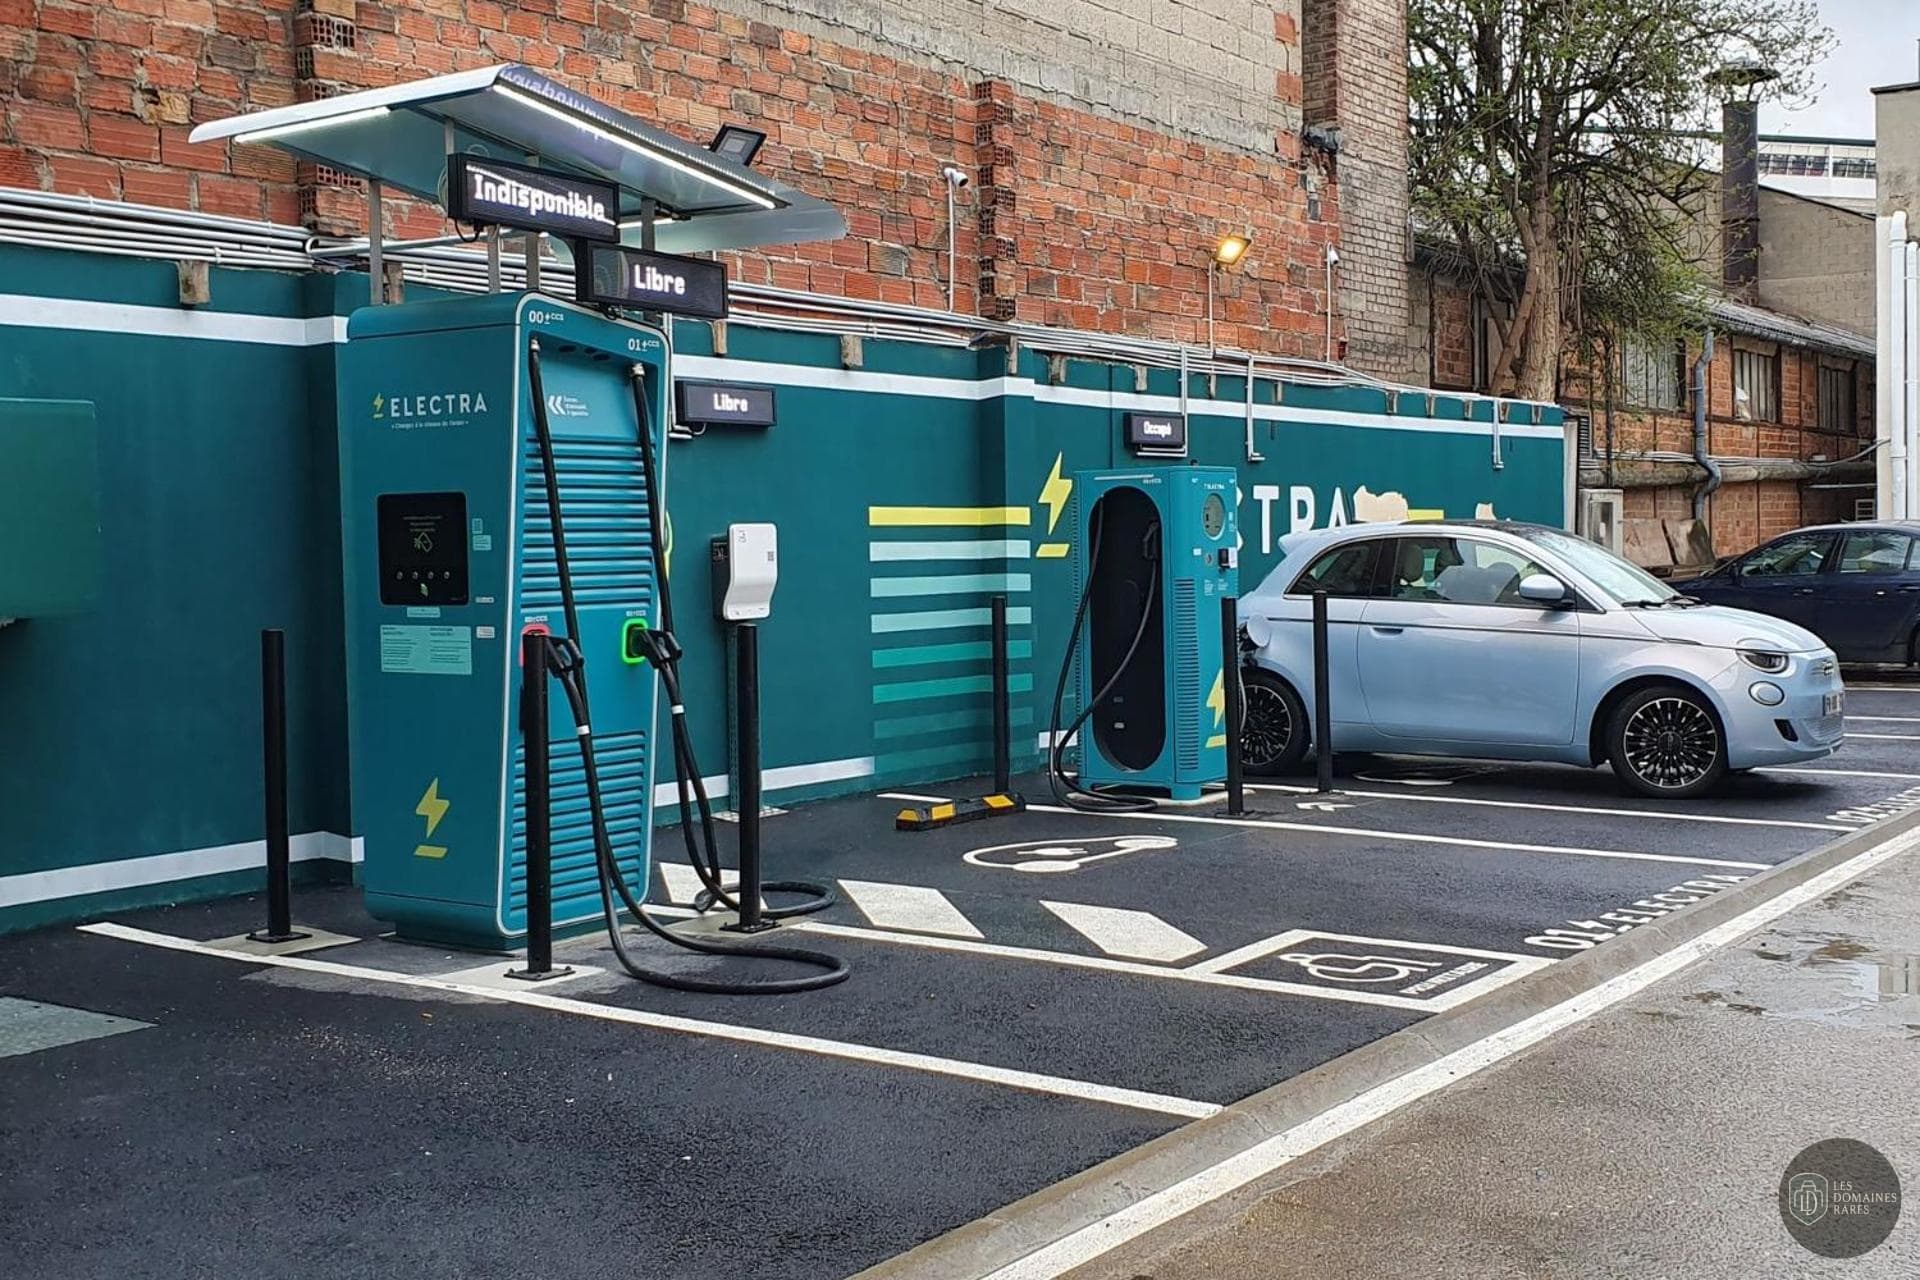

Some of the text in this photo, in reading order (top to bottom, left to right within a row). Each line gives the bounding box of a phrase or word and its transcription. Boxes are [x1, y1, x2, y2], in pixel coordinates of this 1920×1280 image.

[473, 174, 606, 219] Indisponible
[634, 264, 686, 296] Libre
[528, 310, 543, 324] 00
[628, 338, 642, 351] 01
[390, 392, 487, 418] ELECTRA
[713, 393, 748, 413] Libre
[1600, 874, 1750, 923] ELECTRA
